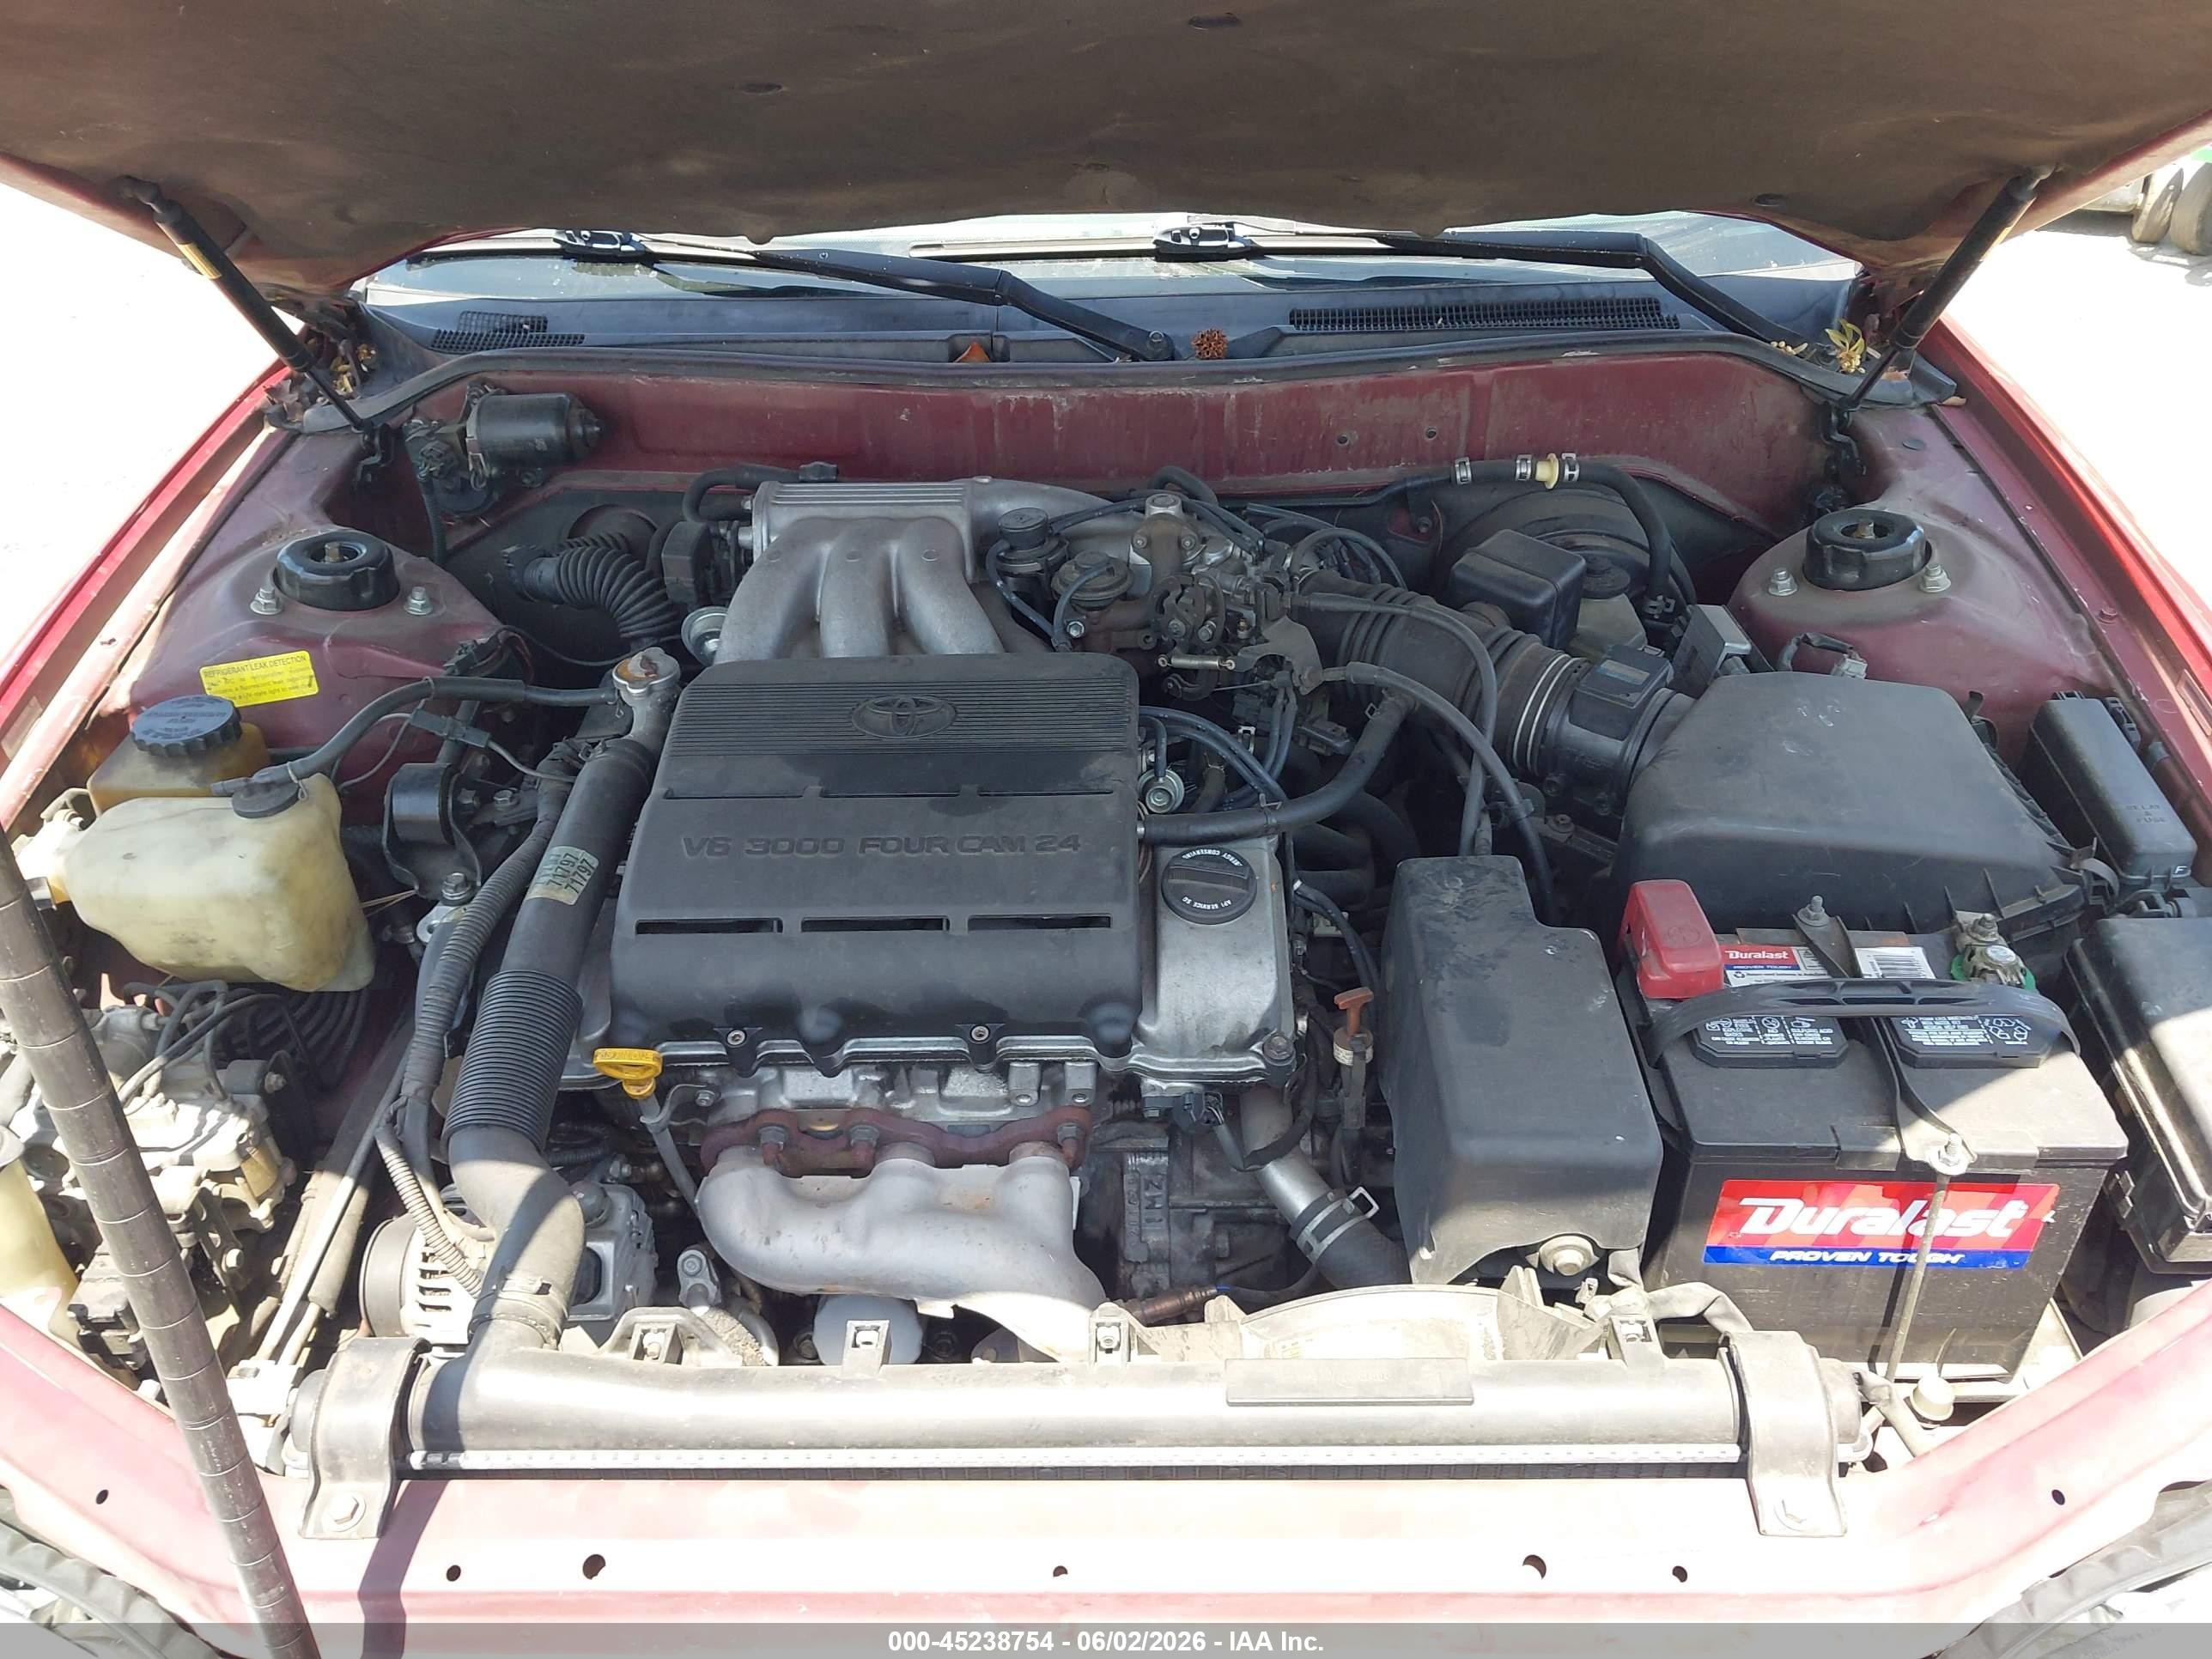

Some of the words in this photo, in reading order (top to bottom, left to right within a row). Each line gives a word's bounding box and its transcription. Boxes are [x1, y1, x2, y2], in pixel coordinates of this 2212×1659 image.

[204, 665, 250, 678] REFRIGERANT
[250, 660, 268, 671] LEAK
[269, 655, 307, 667] DETECTION
[683, 836, 732, 857] V6
[745, 836, 846, 856] 3000
[860, 836, 949, 855] FOUR
[957, 835, 1026, 854] CAM
[1035, 834, 1081, 854] 24
[1182, 849, 1220, 859] CONSERVING
[546, 853, 579, 886] 71797
[564, 859, 595, 893] 71797
[1725, 950, 1790, 960] Duralast
[1739, 1197, 2029, 1237] Duralast
[1769, 1250, 1872, 1264] PROVEN
